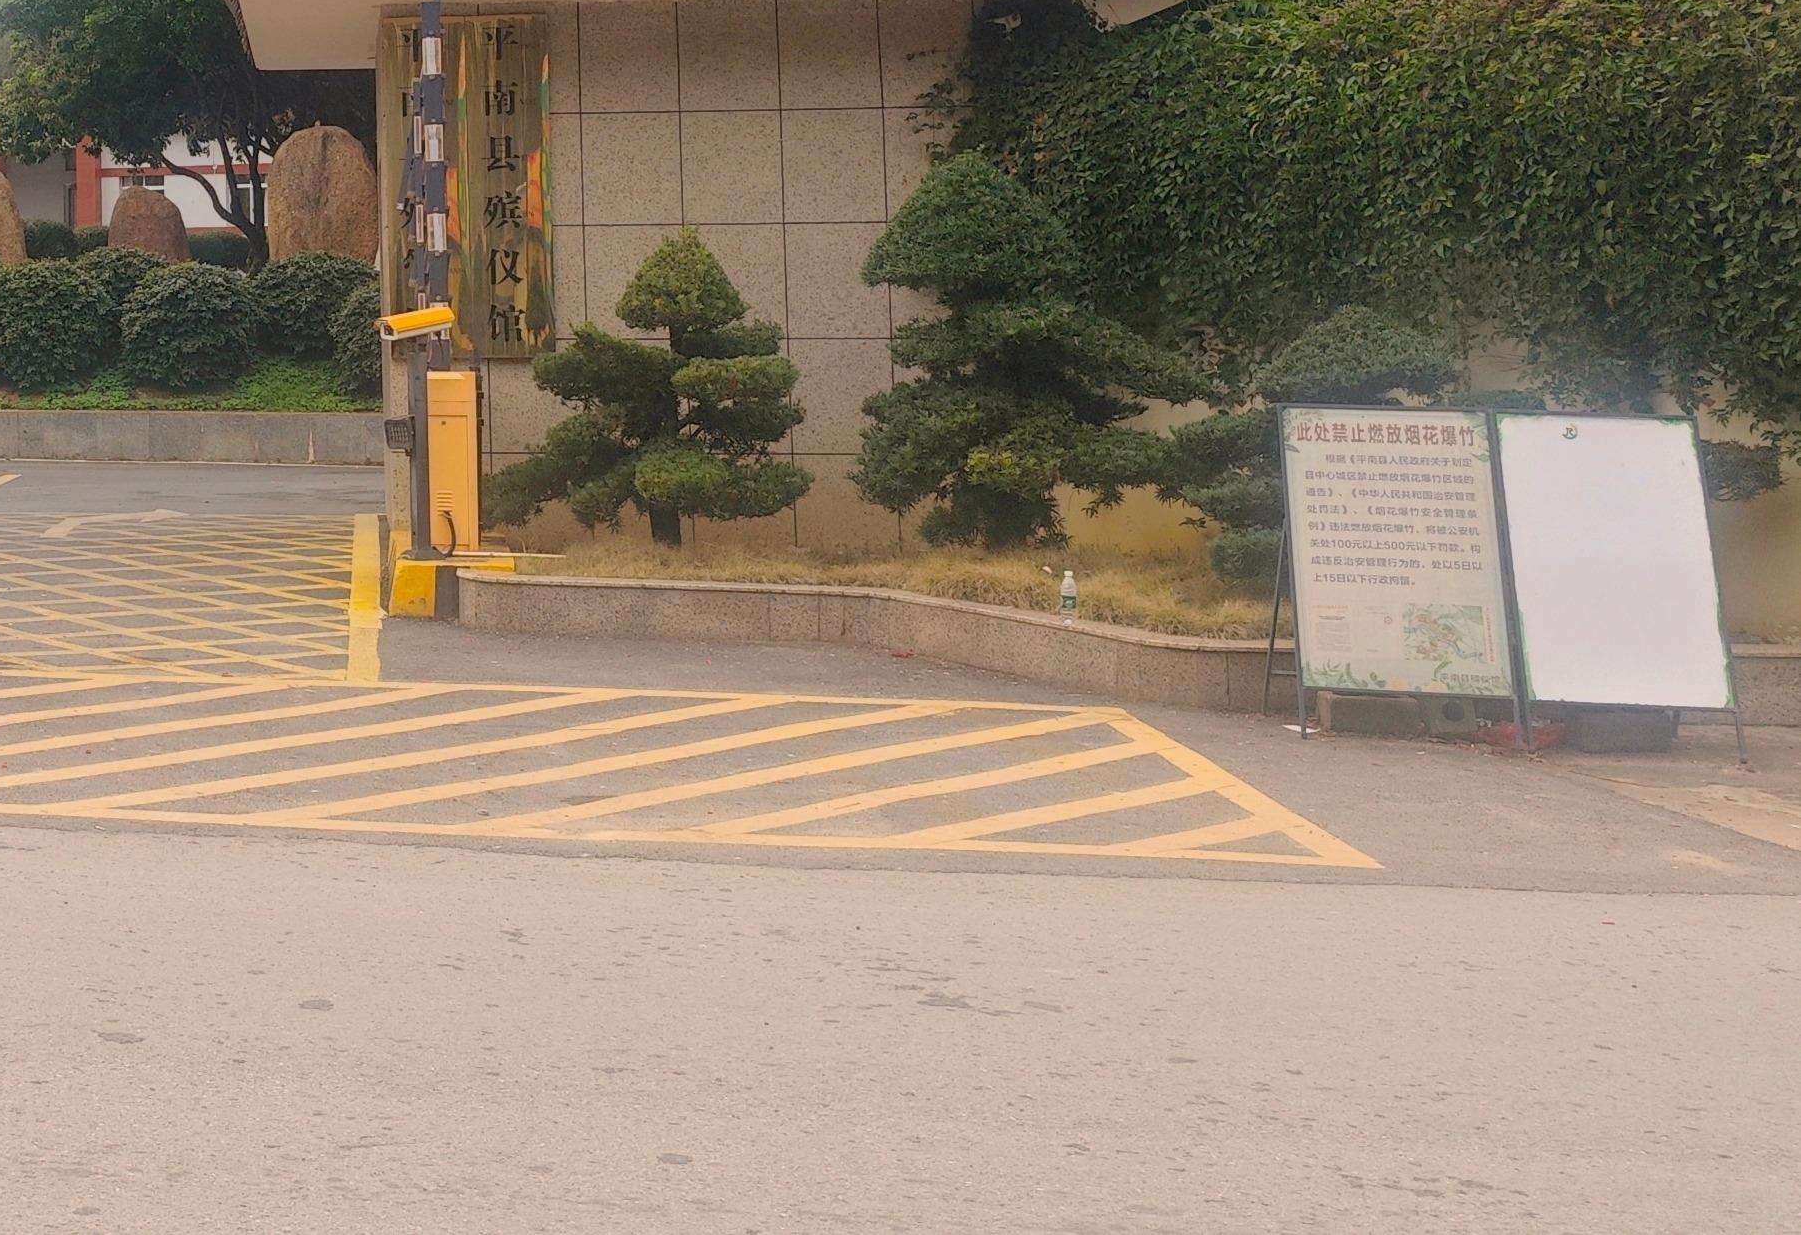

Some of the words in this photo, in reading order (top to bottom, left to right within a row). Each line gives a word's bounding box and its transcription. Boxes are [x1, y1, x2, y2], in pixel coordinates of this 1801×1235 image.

[481, 22, 526, 342] 平南县殡仪馆
[1297, 421, 1475, 447] 此处禁止燃放烟花爆竹
[1325, 453, 1472, 468] 根据《平南县人民政府关于划定
